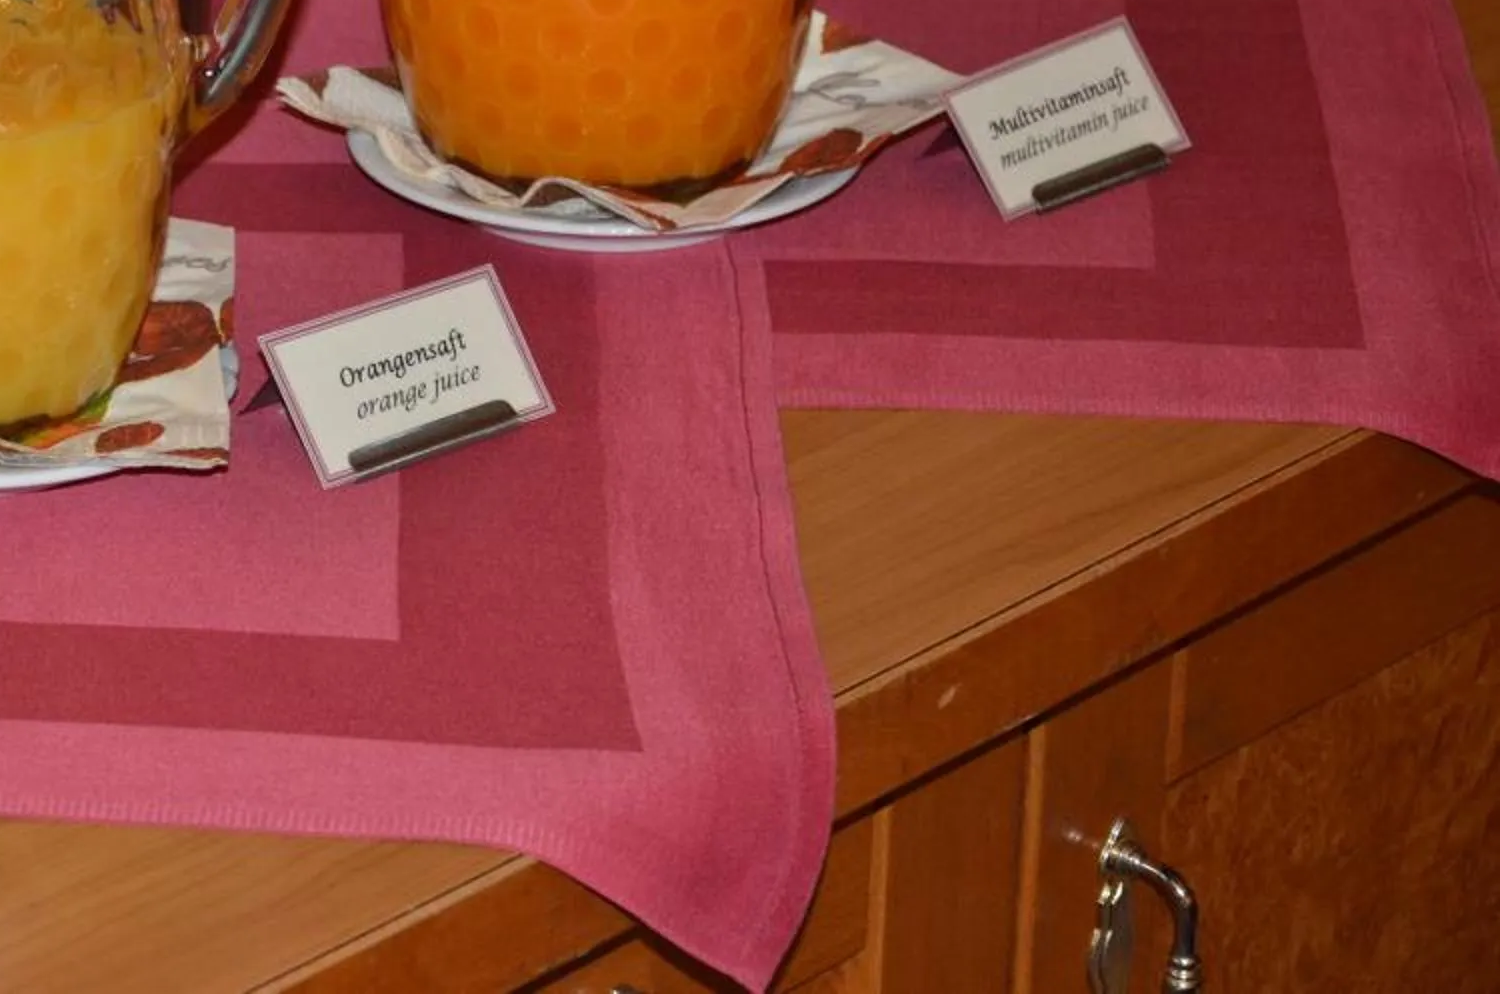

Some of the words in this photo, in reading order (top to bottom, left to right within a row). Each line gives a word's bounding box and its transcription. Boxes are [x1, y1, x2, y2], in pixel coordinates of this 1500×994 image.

[990, 67, 1130, 140] Multivitaminsaft
[1000, 111, 1110, 170] multivitamin
[1112, 95, 1150, 131] juice
[339, 328, 467, 388] Orangensaft
[357, 382, 427, 419] orange
[431, 364, 481, 404] juice
